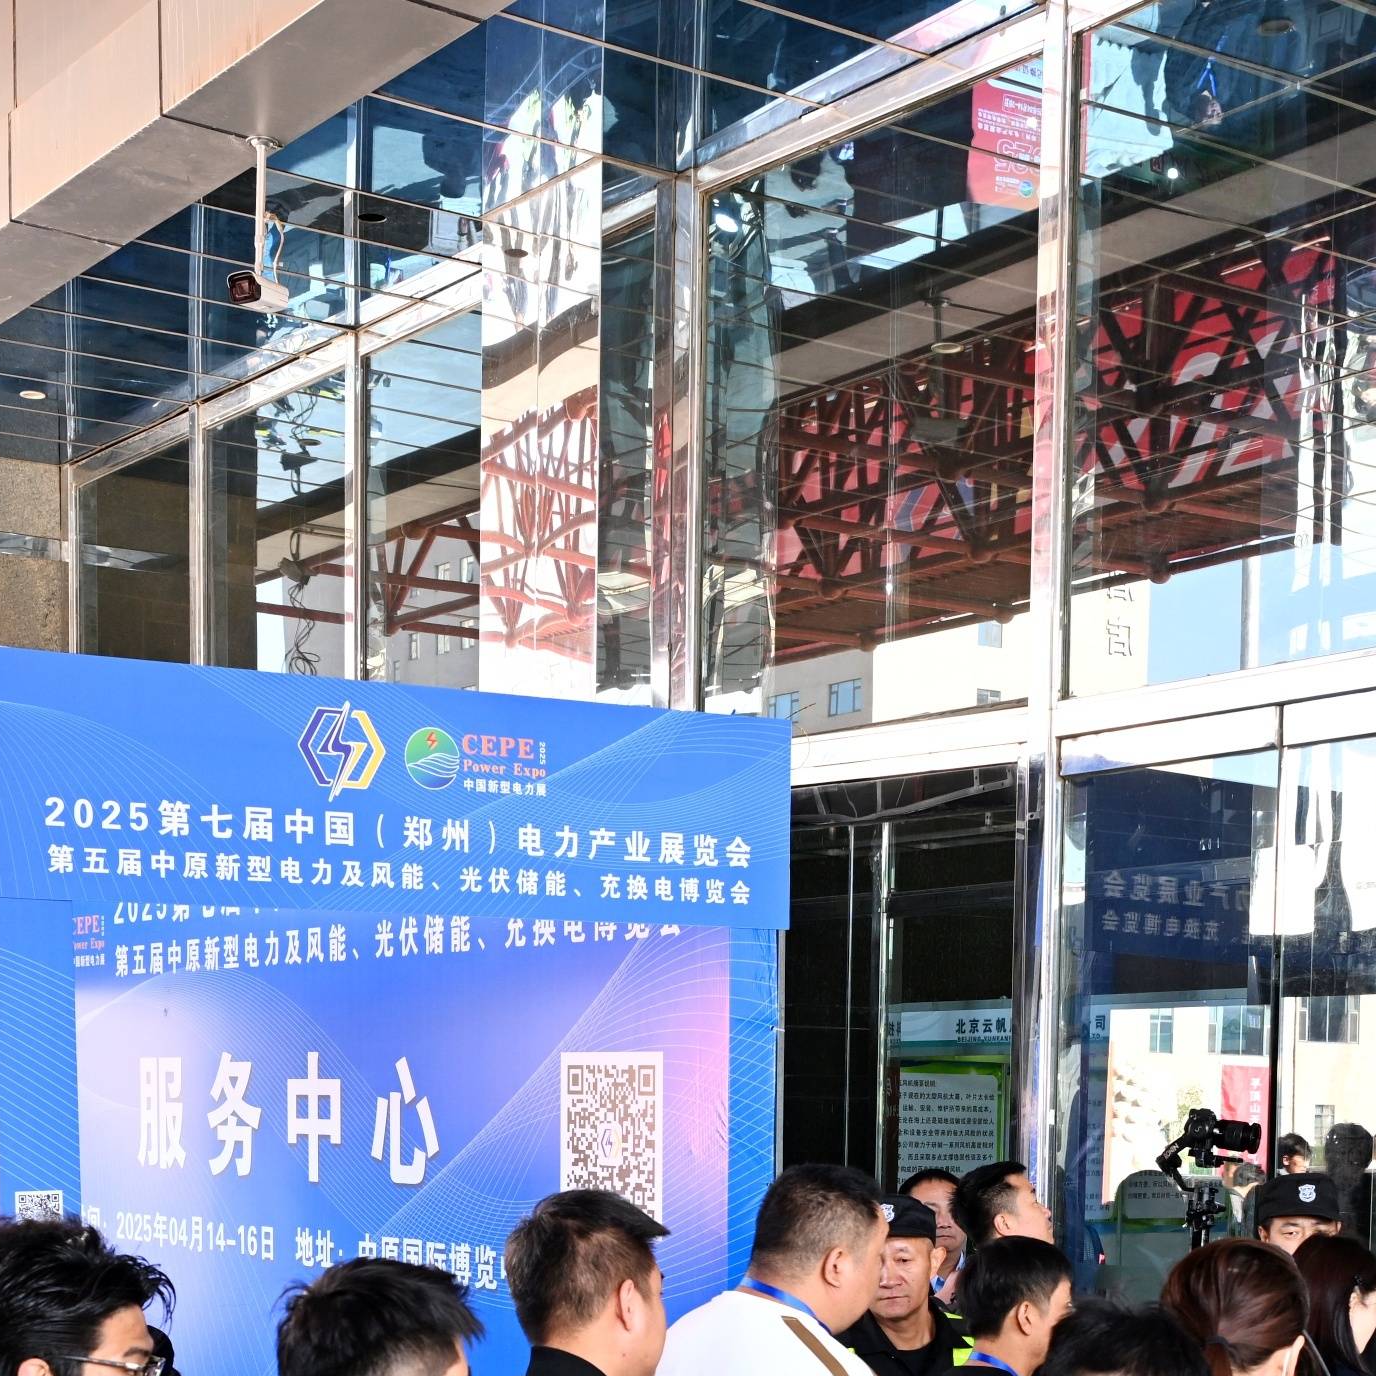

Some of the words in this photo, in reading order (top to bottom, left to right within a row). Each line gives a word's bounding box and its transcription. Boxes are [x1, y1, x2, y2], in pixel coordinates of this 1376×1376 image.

[462, 734, 535, 760] CEPE
[538, 741, 546, 765] 2025
[463, 759, 506, 775] Power
[513, 762, 546, 778] Expo
[463, 778, 547, 797] 中国新型电力展
[44, 795, 753, 869] 2025第七届中国（郑州）电力产业展览会
[47, 843, 751, 906] 第五届中原新型电力及风能、光伏储能、充换电博览会
[73, 954, 105, 968] 国新型电力展
[955, 1017, 1013, 1034] 北京云帆
[136, 1050, 439, 1186] 服务中心
[116, 1211, 276, 1262] 2025年04月14-16日
